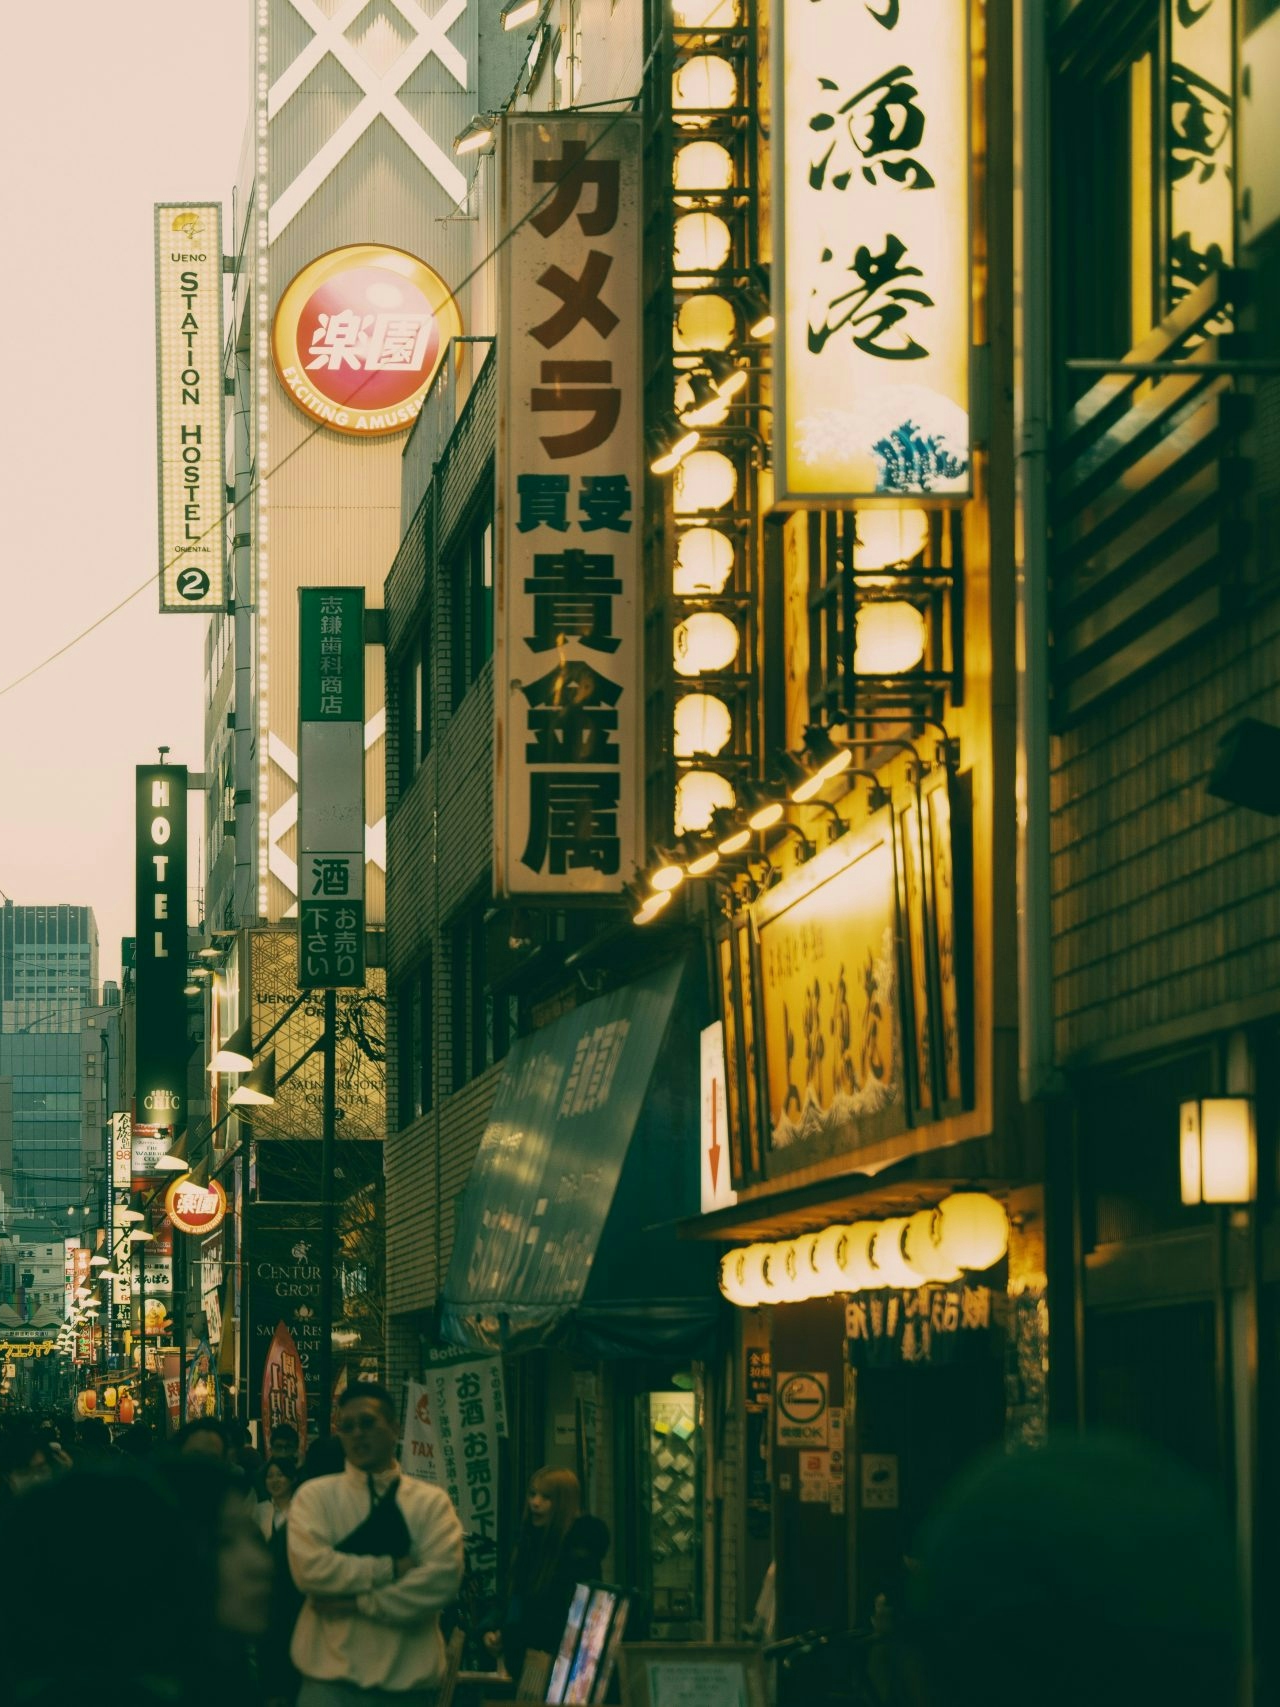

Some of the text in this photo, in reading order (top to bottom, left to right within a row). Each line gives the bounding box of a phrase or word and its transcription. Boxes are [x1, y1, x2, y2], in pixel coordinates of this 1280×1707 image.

[171, 253, 207, 263] UENO
[529, 140, 622, 460] カメラ
[304, 308, 434, 372] 楽園
[179, 271, 201, 540] STATION HOSTEL
[282, 366, 350, 427] EXCITING
[174, 545, 211, 553] ORIENTAL
[182, 572, 205, 595] 2
[319, 595, 344, 715] 志鎌歯科商店
[521, 549, 624, 876] 貴金属
[151, 780, 171, 958] HOTEL
[312, 858, 349, 897] 酒
[307, 907, 329, 977] 下さい
[334, 907, 357, 977] お売り
[257, 993, 296, 1004] UENO
[144, 1096, 180, 1109] CHIC
[275, 1283, 320, 1297] GROU
[299, 1355, 309, 1368] 2
[411, 1441, 435, 1458] TAX
